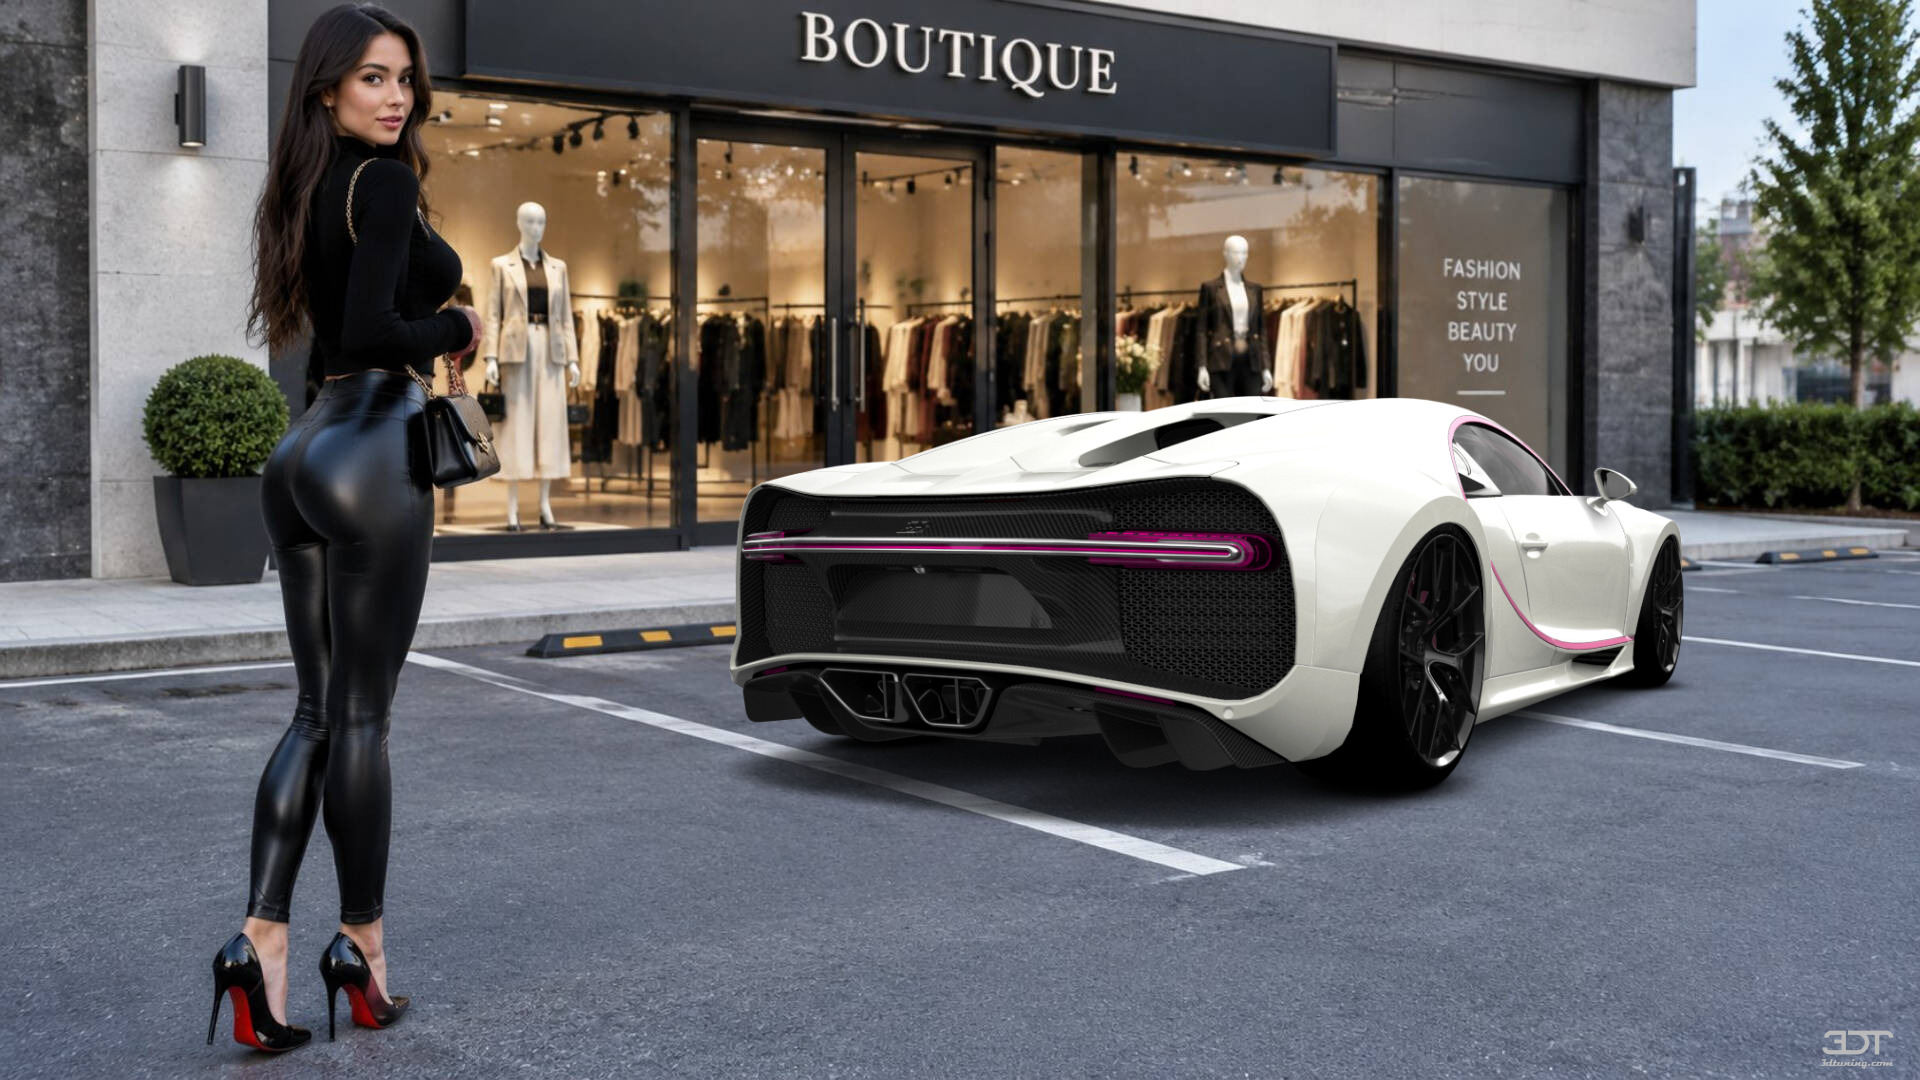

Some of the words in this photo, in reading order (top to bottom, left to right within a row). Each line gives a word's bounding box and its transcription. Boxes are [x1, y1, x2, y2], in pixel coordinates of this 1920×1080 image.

[801, 11, 1117, 98] BOUTIQUE
[1443, 258, 1521, 280] FASHION
[1457, 291, 1508, 311] STYLE
[1448, 321, 1517, 342] BEAUTY
[1464, 353, 1499, 373] YOU
